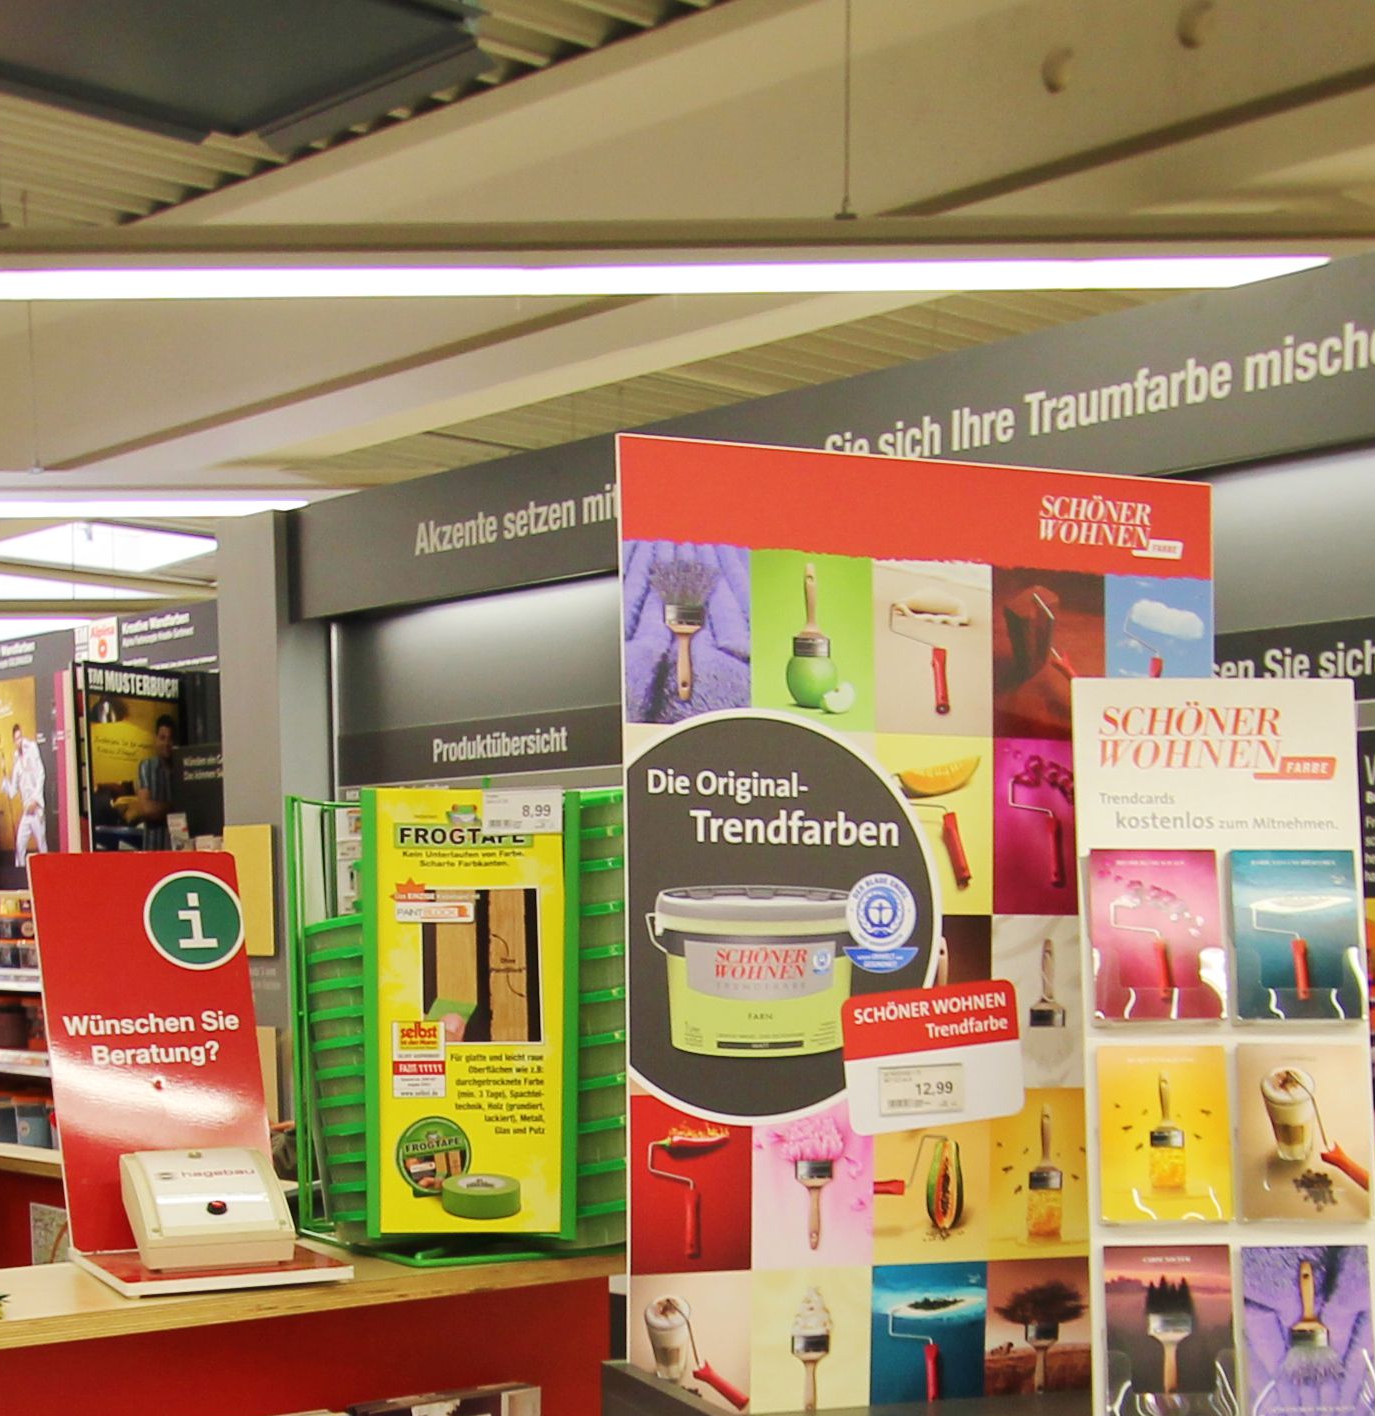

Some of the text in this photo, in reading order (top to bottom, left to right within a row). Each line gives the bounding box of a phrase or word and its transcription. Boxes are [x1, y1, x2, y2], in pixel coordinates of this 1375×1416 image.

[877, 416, 942, 459] sich
[952, 407, 1014, 452] Ihre
[1025, 357, 1232, 437] Traumfarbe
[415, 483, 617, 556] Akzente setzen mit
[1038, 494, 1152, 527] SCHÖNER
[1038, 519, 1152, 550] WOHNEN
[1263, 648, 1310, 679] Sie
[104, 669, 179, 699] MUSTERBUCH
[1097, 701, 1281, 737] SCHÖNER
[433, 726, 567, 763] Produktübersicht
[1097, 739, 1329, 774] WOHNEN FARBE
[647, 769, 809, 805] Die Original-
[1099, 793, 1175, 805] Trendcards
[522, 804, 551, 818] 8,99
[1116, 811, 1339, 831] kostenlos zum Mitnehmen.
[689, 809, 900, 848] Trendfarben
[714, 945, 808, 963] SCHÖNER
[714, 963, 807, 980] WOHNEN
[63, 1009, 240, 1036] Wünschen Sie
[853, 992, 1007, 1026] SCHÖNER WOHNEN
[400, 1022, 437, 1038] selbst
[925, 1015, 1009, 1040] Trendfarbe
[91, 1040, 220, 1067] Beratung?
[404, 1137, 461, 1153] FROGTAPE
[181, 1166, 256, 1180] hagebau
